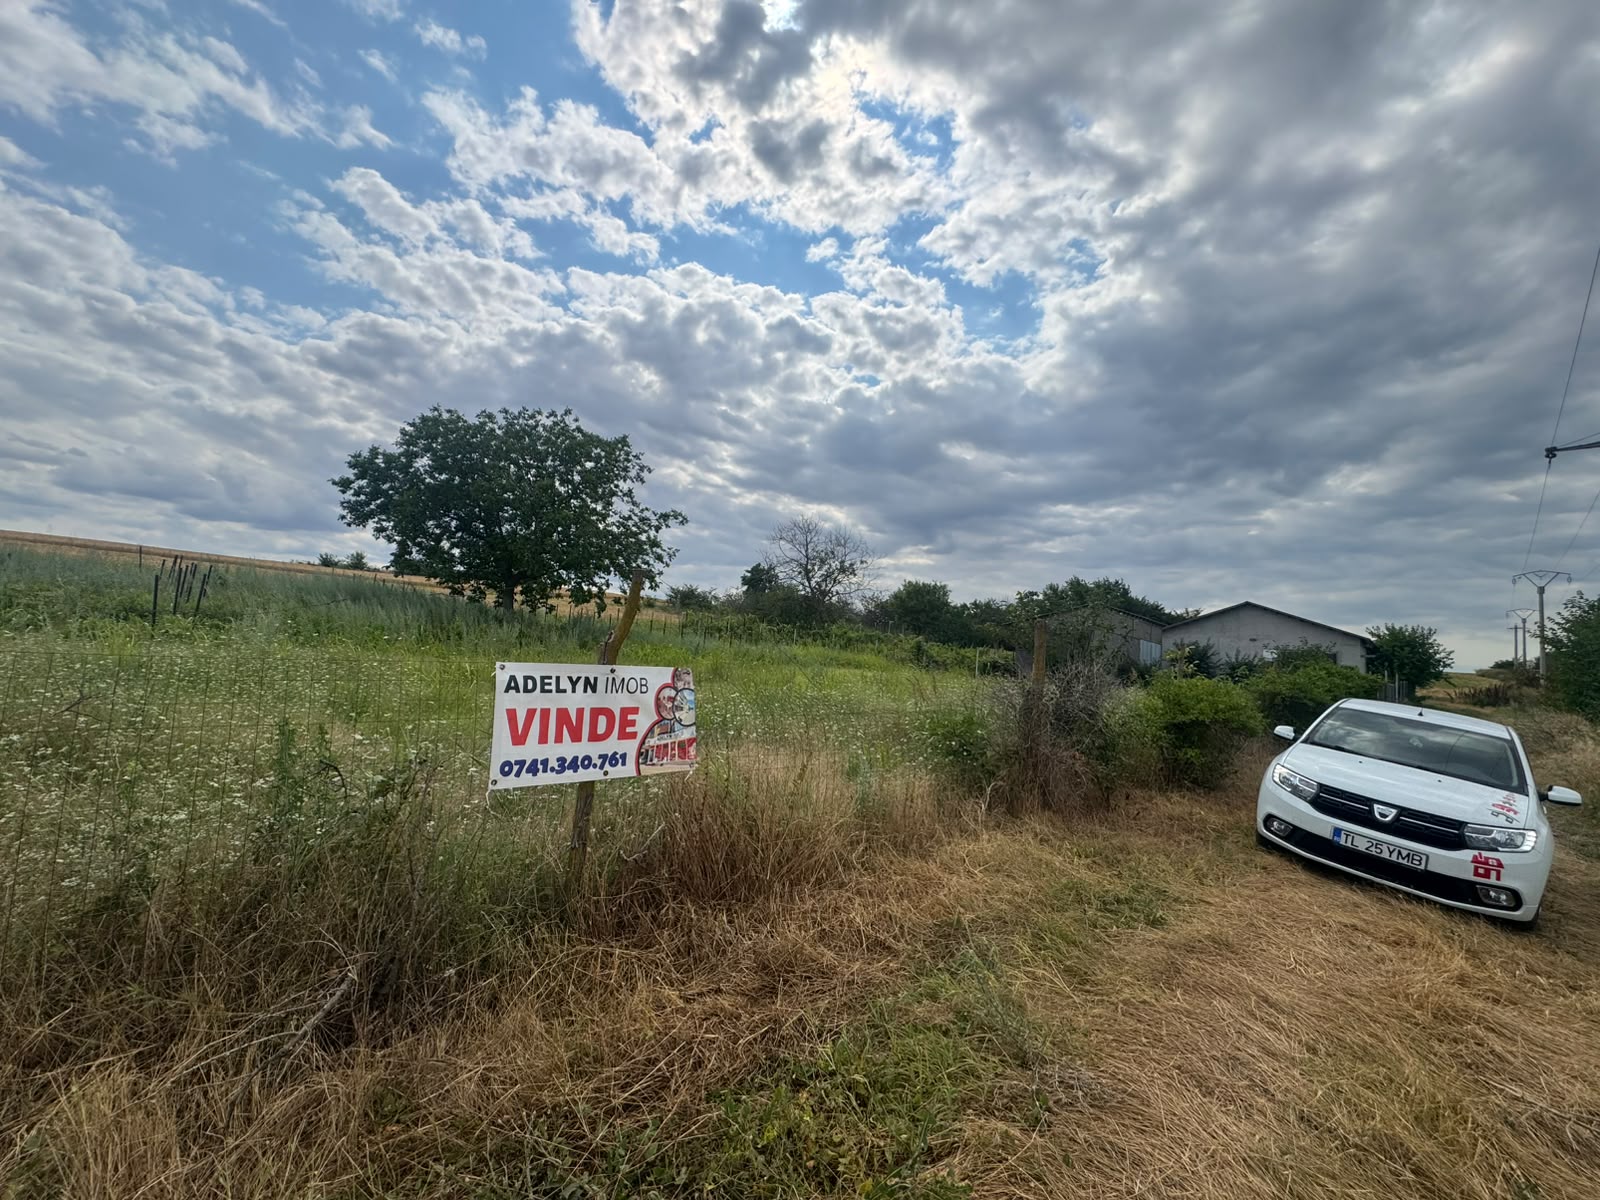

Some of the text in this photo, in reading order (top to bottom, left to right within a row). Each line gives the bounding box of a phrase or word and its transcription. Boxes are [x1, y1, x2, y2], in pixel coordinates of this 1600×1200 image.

[504, 675, 649, 695] ADELYN IMOB
[505, 707, 640, 746] VINDE
[499, 752, 627, 778] 0741.340.761
[1343, 832, 1359, 848] TL
[1365, 840, 1383, 855] 25
[1387, 846, 1423, 867] YMB
